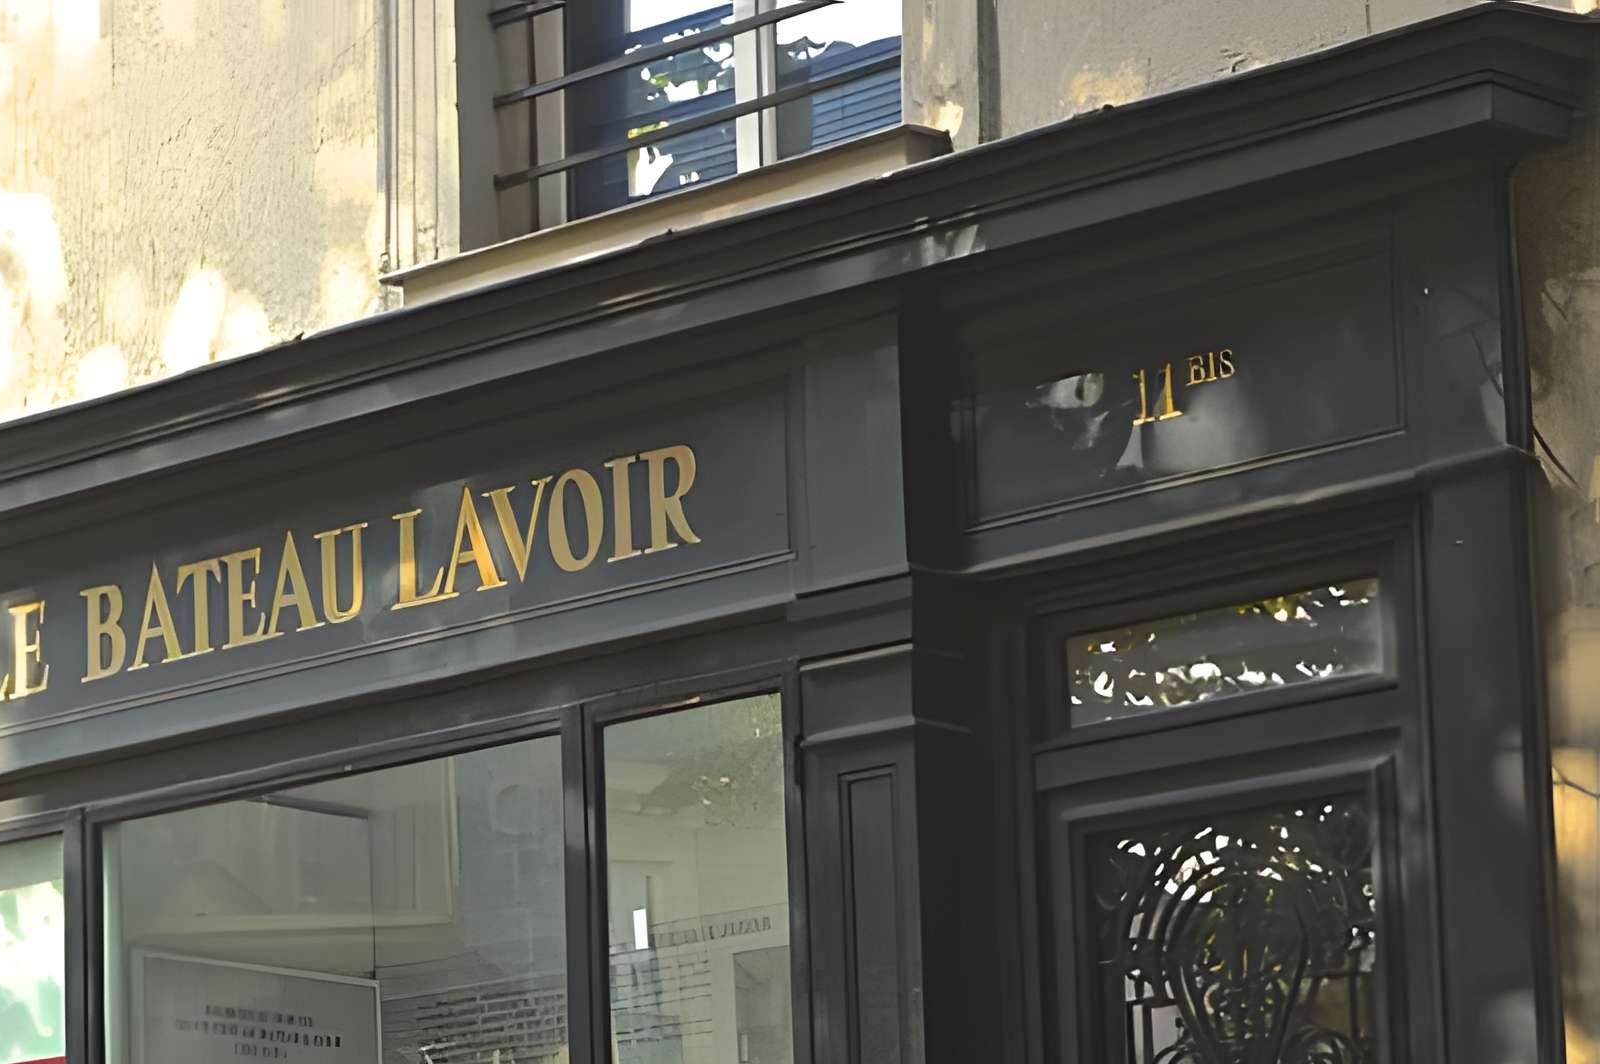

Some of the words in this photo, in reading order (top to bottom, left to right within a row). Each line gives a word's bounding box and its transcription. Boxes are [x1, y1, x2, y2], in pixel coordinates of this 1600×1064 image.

[1132, 362, 1184, 426] 11
[1185, 348, 1236, 387] BIS
[80, 521, 369, 684] BATEAU
[391, 444, 702, 611] LAVOIR
